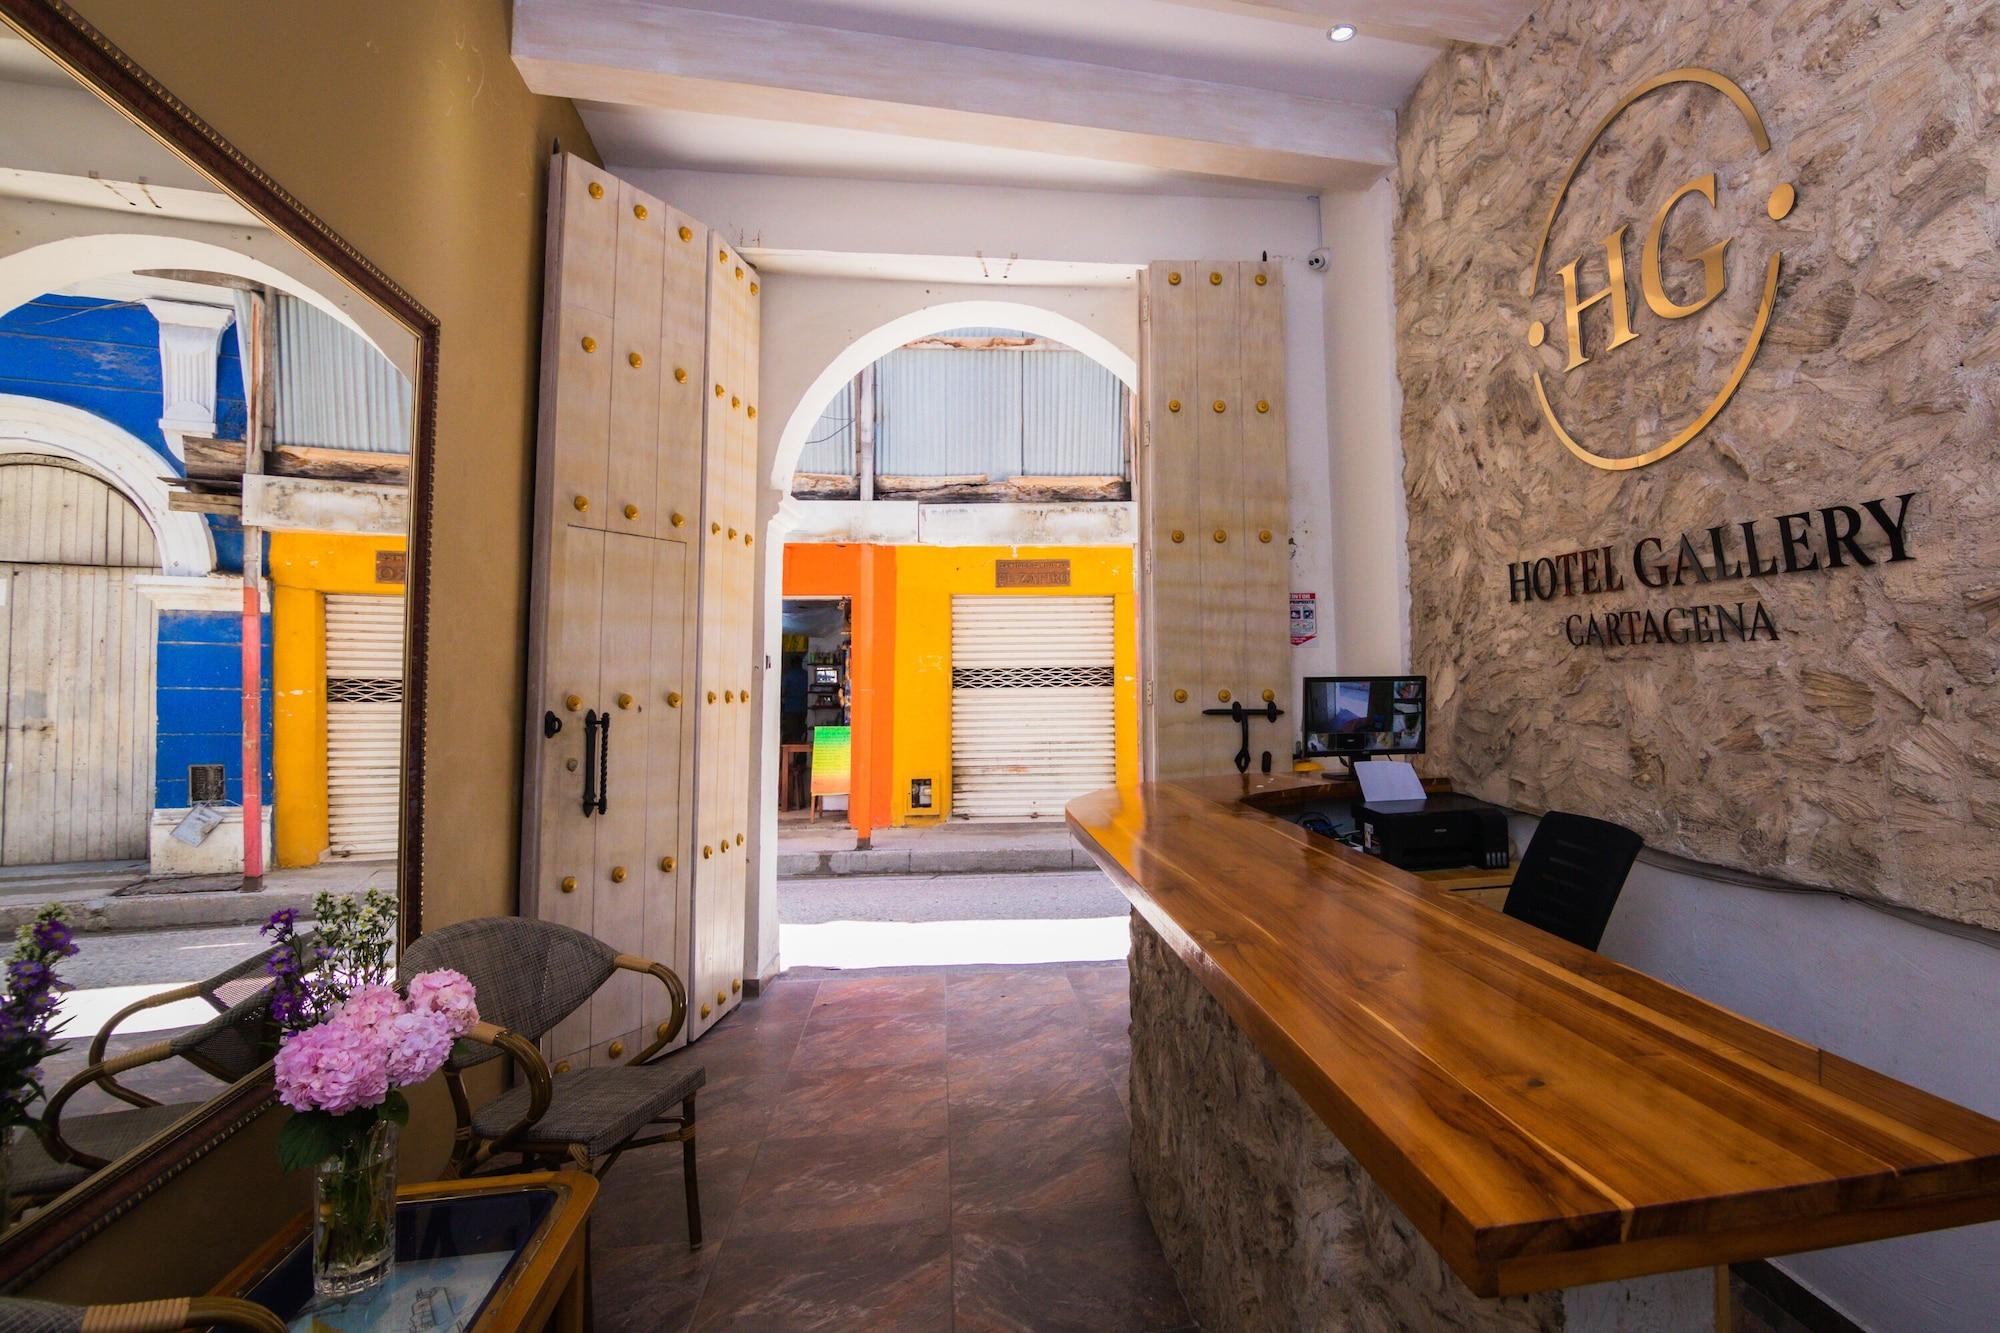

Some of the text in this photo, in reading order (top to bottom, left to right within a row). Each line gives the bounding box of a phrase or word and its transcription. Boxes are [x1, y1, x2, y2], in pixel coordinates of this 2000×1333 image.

[1555, 172, 1732, 373] HG
[1508, 492, 1917, 602] HOTEL GALLERY
[1565, 600, 1781, 648] CARTAGENA
